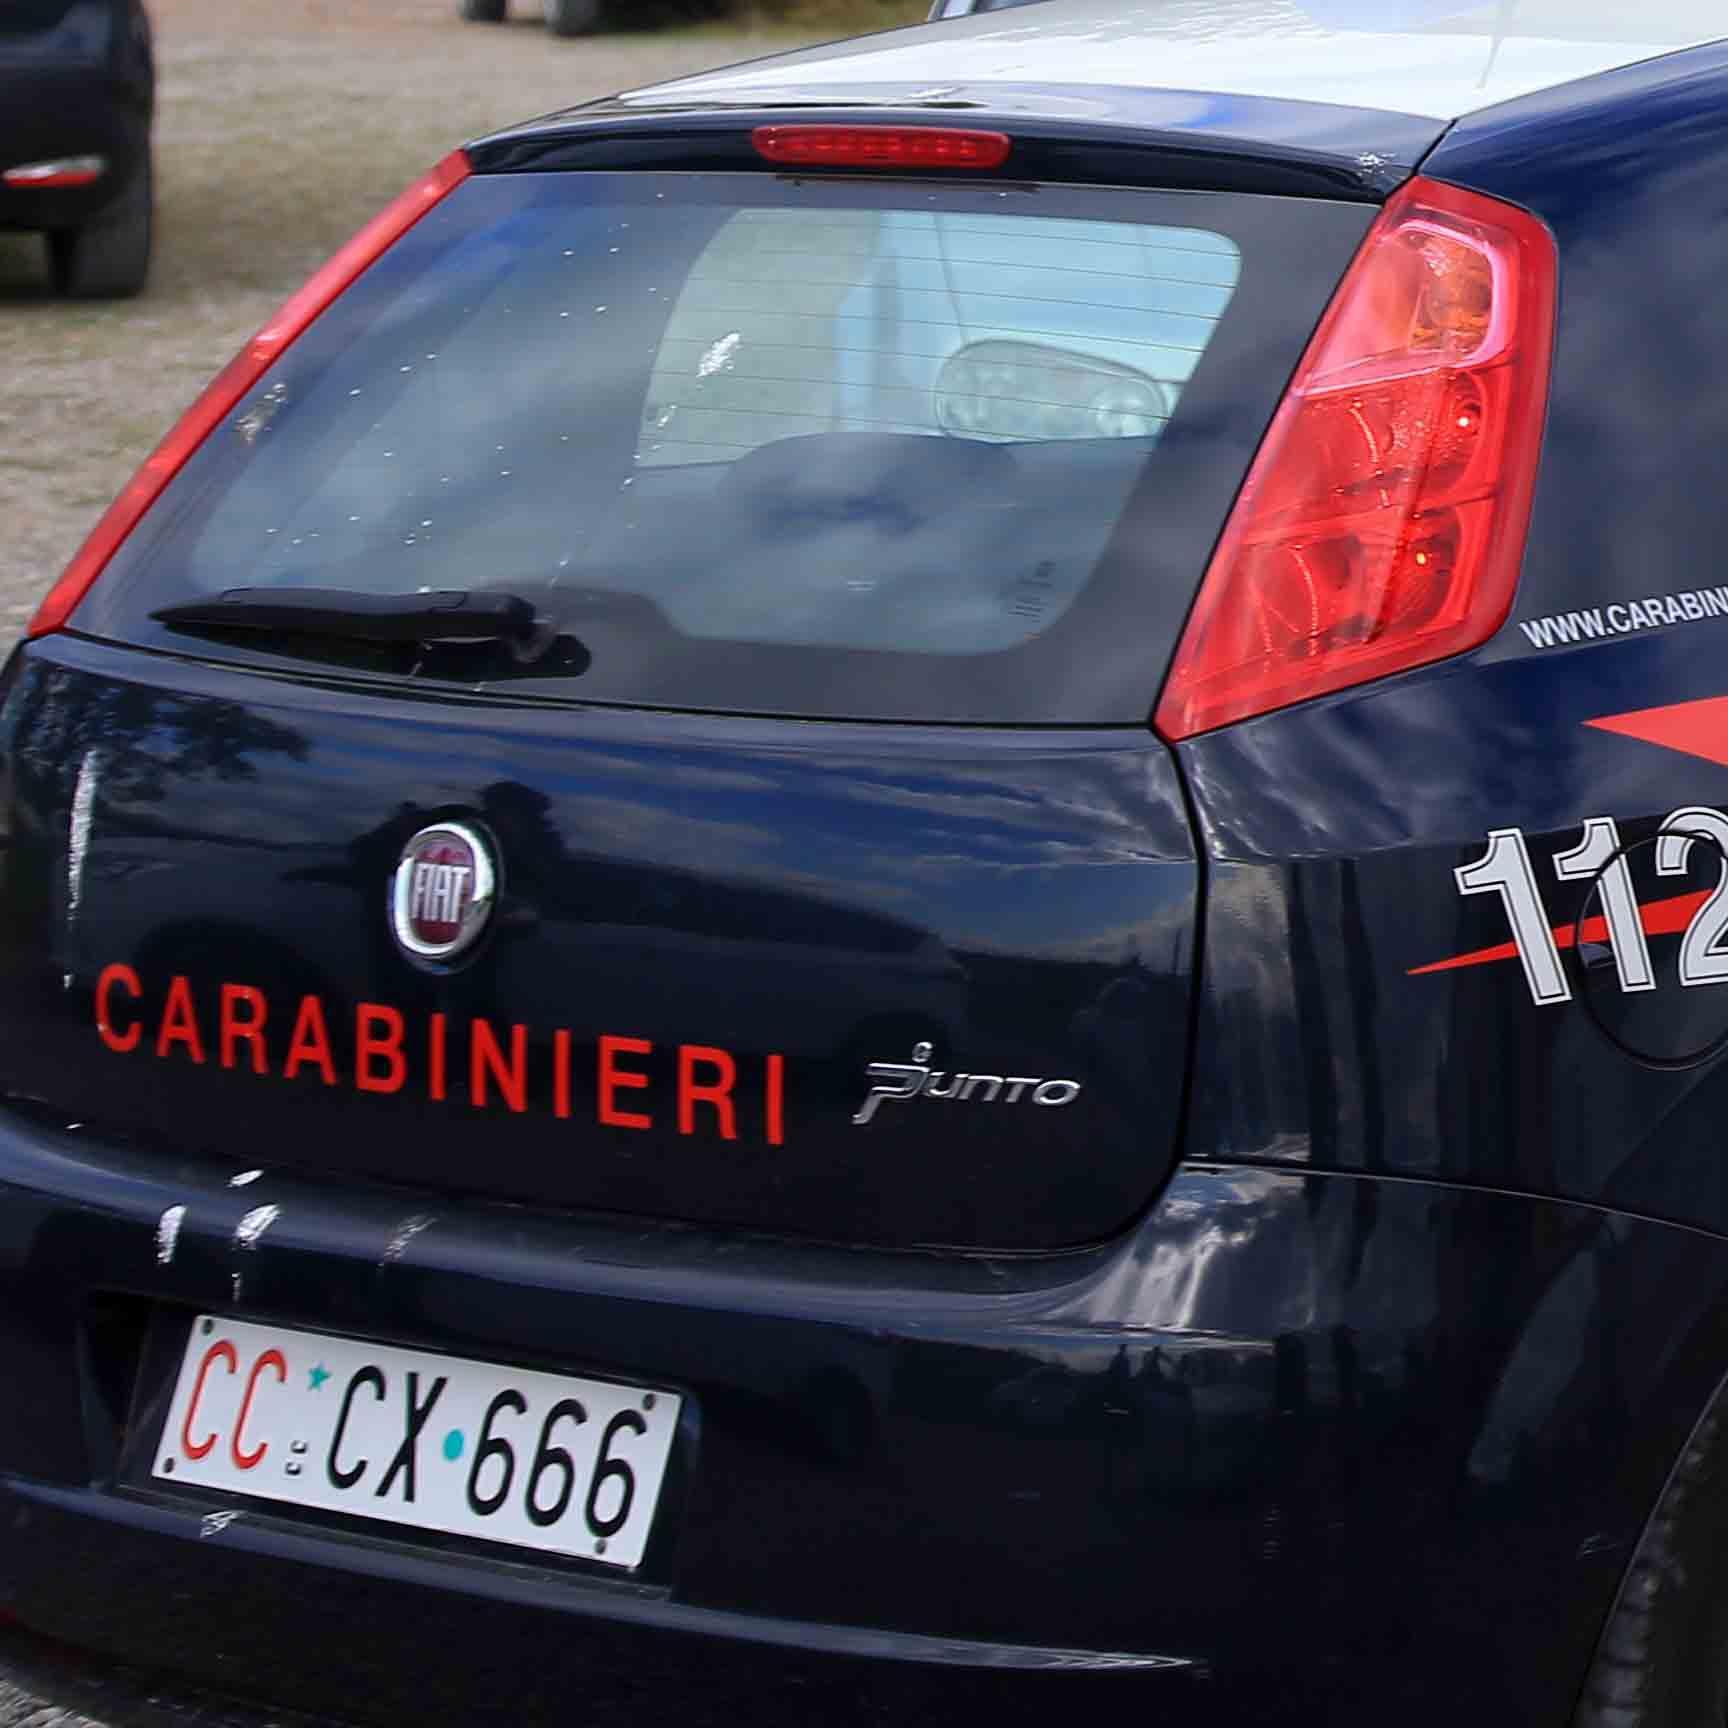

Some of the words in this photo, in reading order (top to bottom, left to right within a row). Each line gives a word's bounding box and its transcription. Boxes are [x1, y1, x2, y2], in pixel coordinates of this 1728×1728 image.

[411, 864, 472, 923] FIAT
[95, 962, 785, 1146] CARABINIERI
[182, 1338, 288, 1471] CC
[326, 1364, 448, 1504] CX
[466, 1387, 649, 1539] 666
